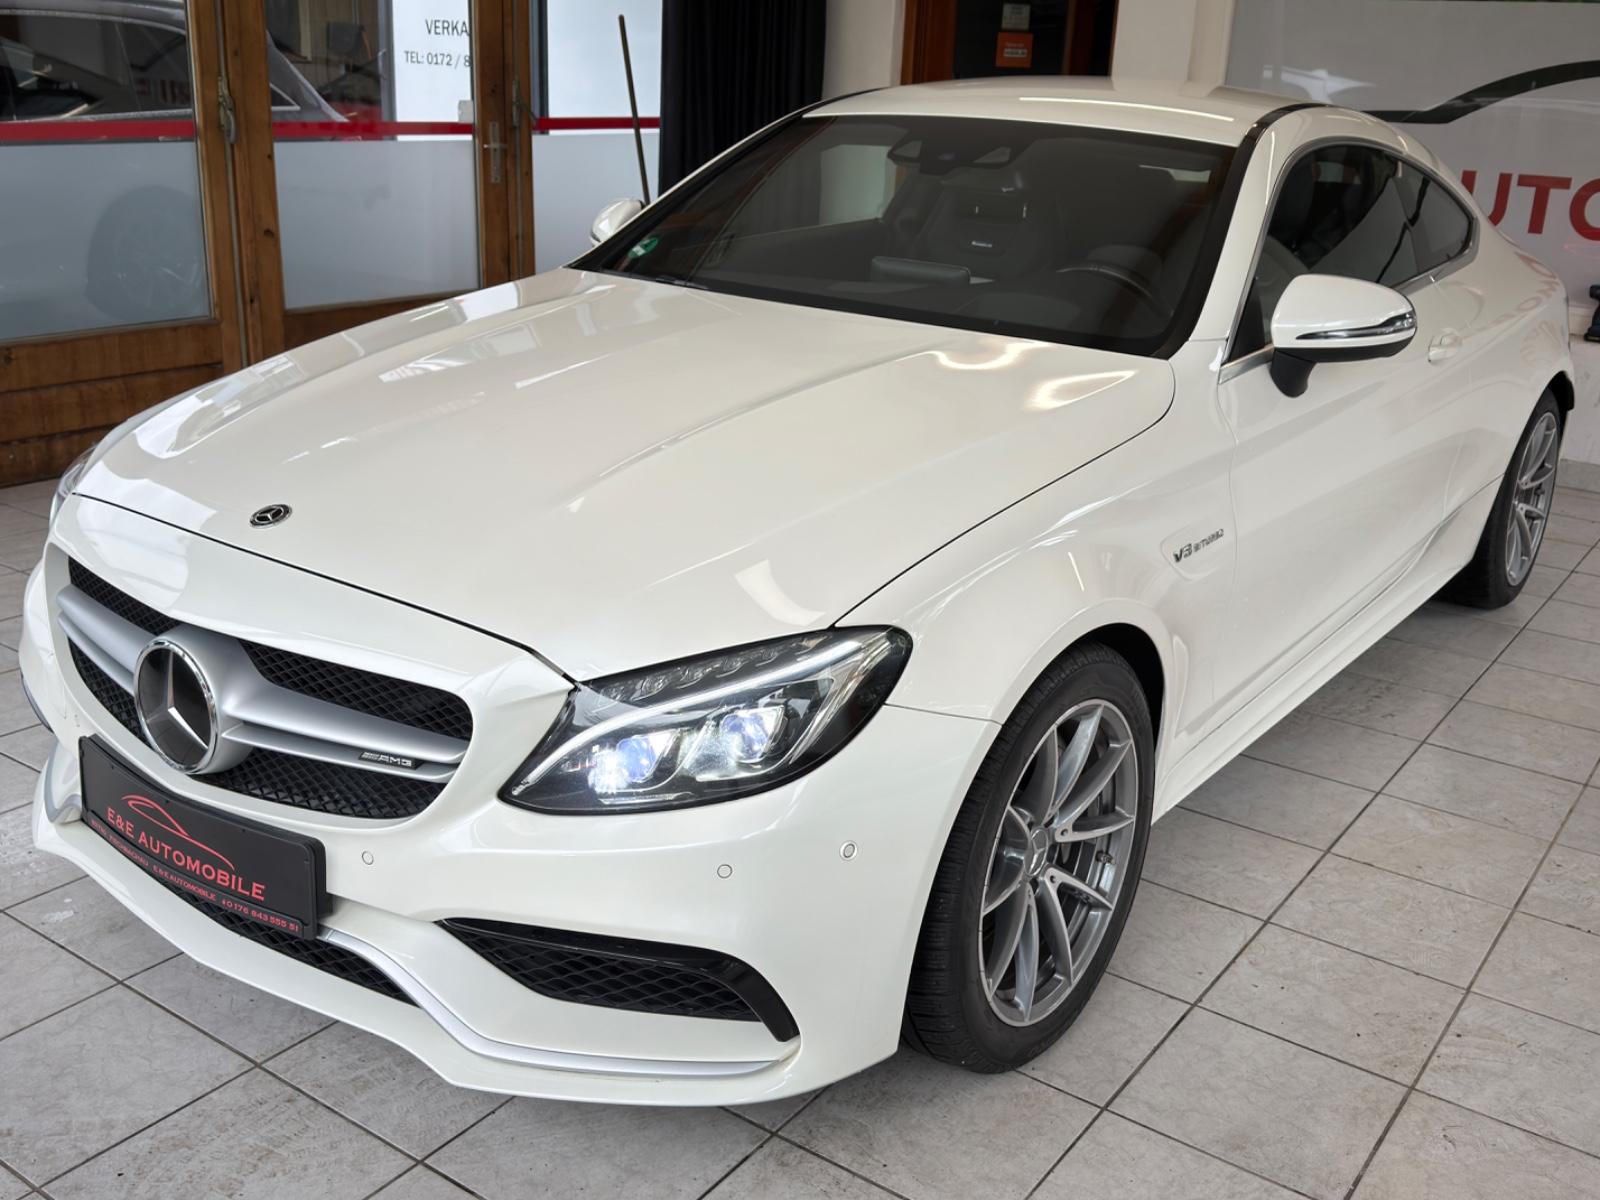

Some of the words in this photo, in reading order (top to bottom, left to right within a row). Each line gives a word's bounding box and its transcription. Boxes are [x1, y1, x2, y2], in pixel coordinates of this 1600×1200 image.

[404, 50, 424, 64] TEL:
[426, 52, 452, 66] 0172
[106, 807, 135, 839] E&E
[138, 831, 265, 900] AUTOMOBILE
